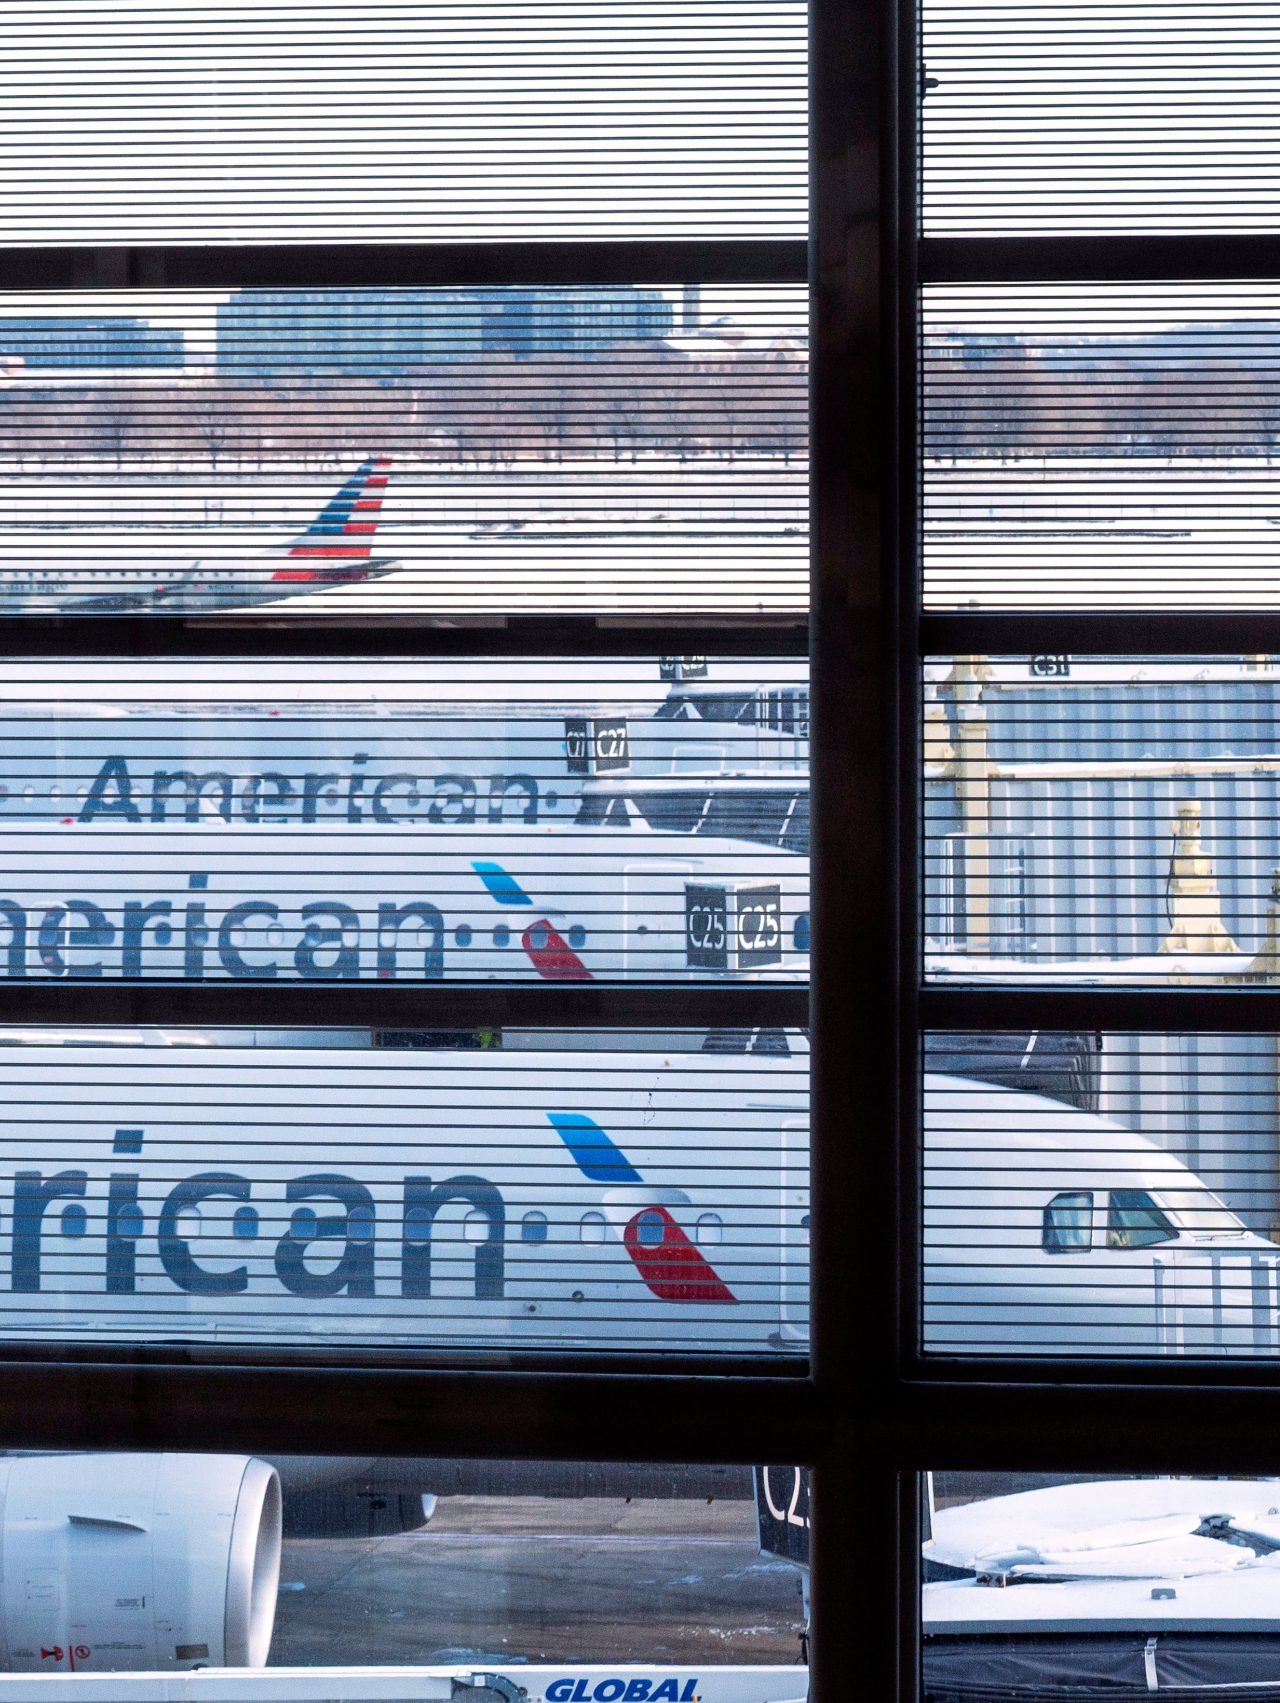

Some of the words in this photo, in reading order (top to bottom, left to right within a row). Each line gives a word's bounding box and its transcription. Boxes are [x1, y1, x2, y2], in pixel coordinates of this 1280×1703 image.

[1034, 655, 1066, 675] C31
[597, 727, 626, 758] C27
[78, 753, 538, 825] American
[689, 905, 725, 950] C25
[738, 903, 779, 950] C25
[545, 1678, 702, 1703] GLOBAL
